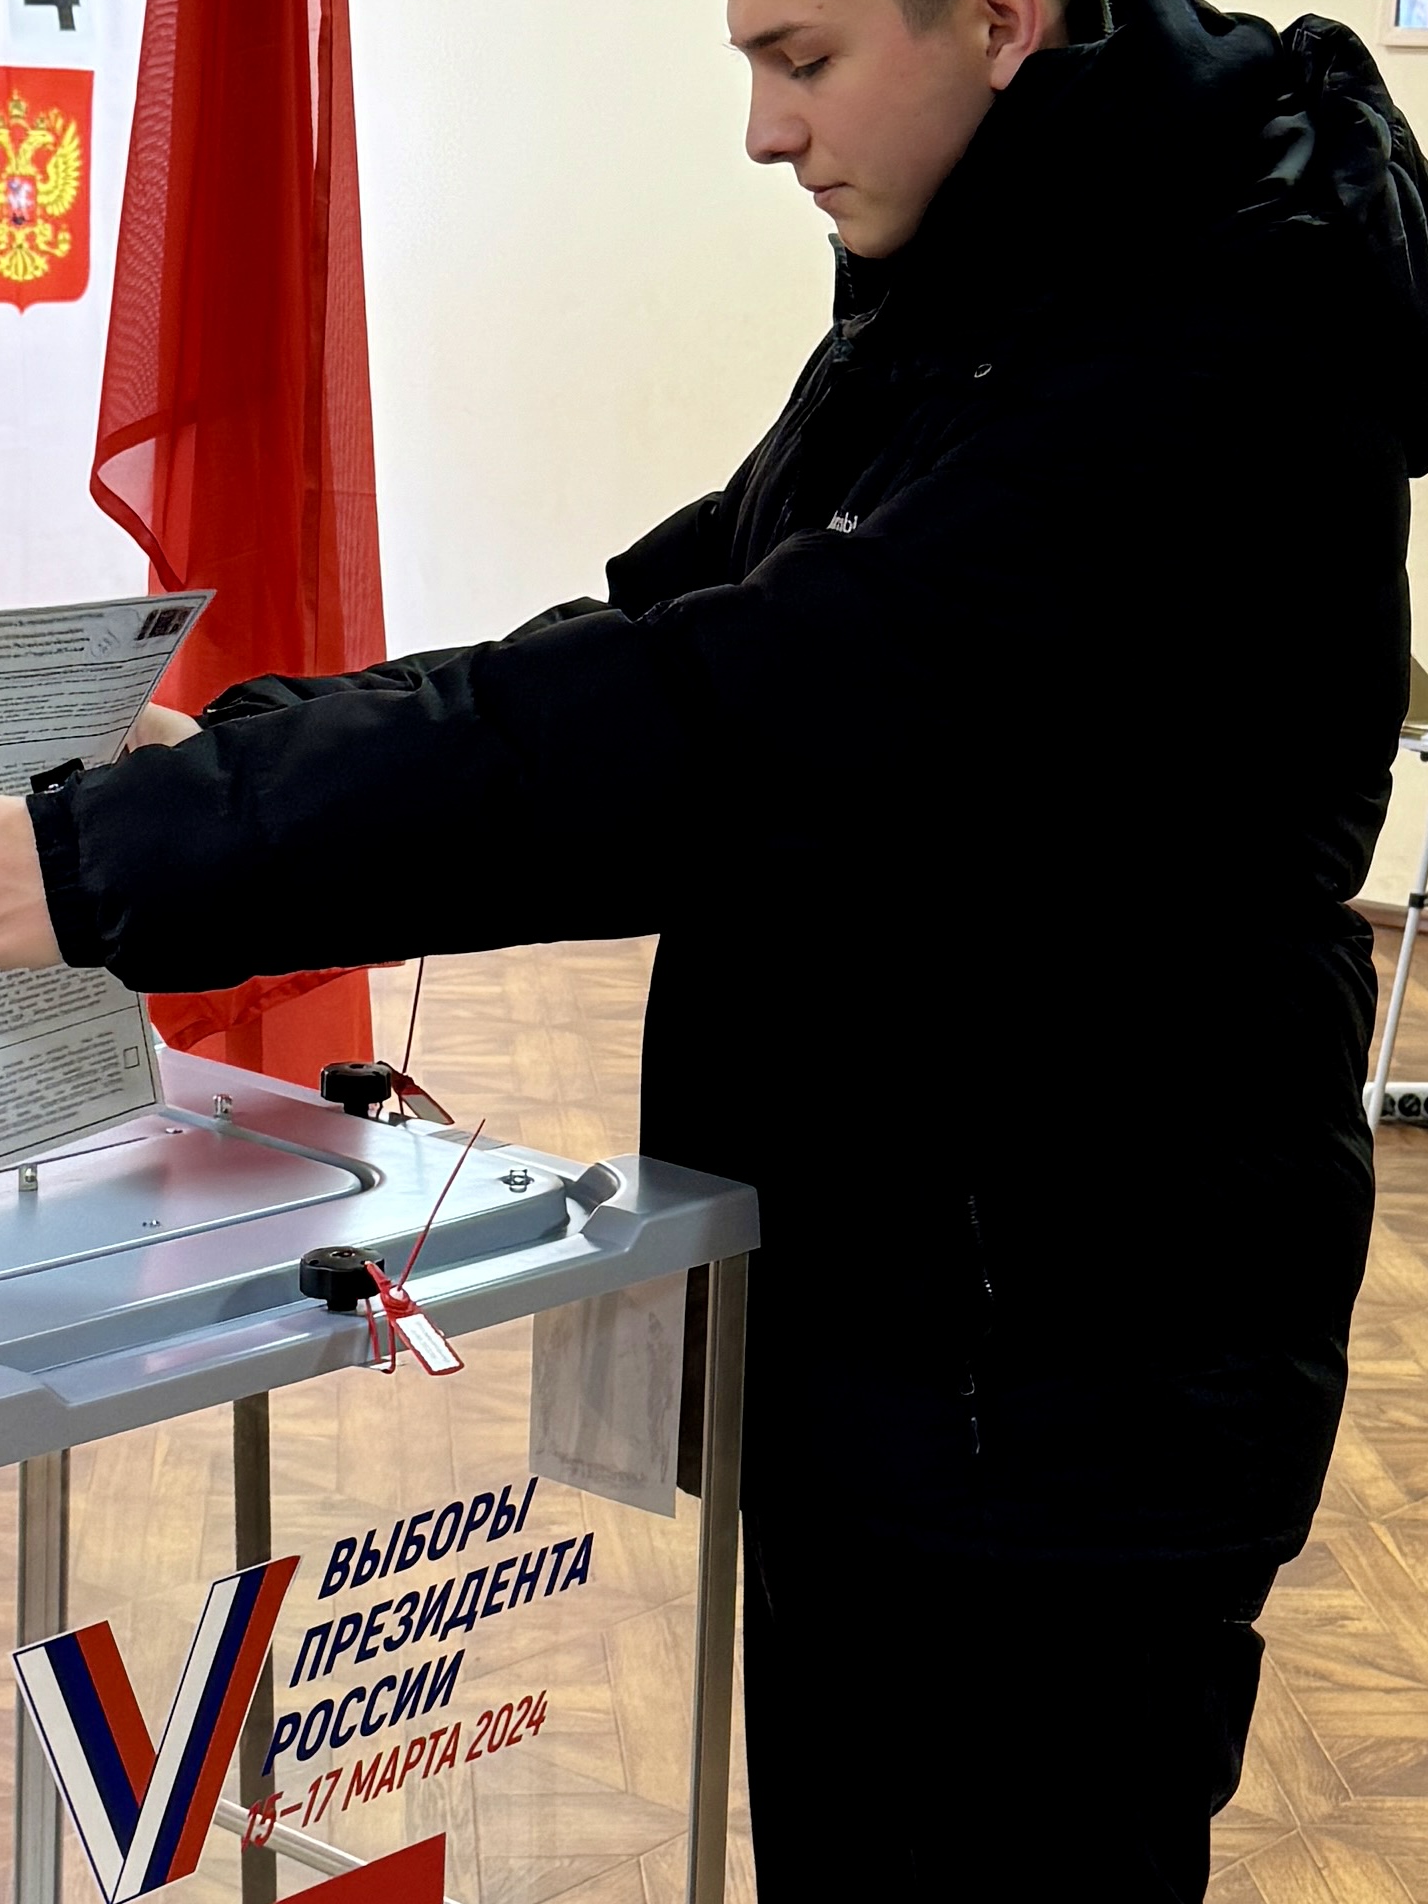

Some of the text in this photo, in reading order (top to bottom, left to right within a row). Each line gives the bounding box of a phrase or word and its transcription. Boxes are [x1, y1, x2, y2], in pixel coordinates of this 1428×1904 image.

[318, 1477, 539, 1600] ВЫБОРЫ
[288, 1531, 595, 1689] ПРЕЗИДЕНТА
[261, 1648, 466, 1777] РОССИИ
[341, 1722, 462, 1811] МАРТА
[465, 1689, 549, 1763] 2024
